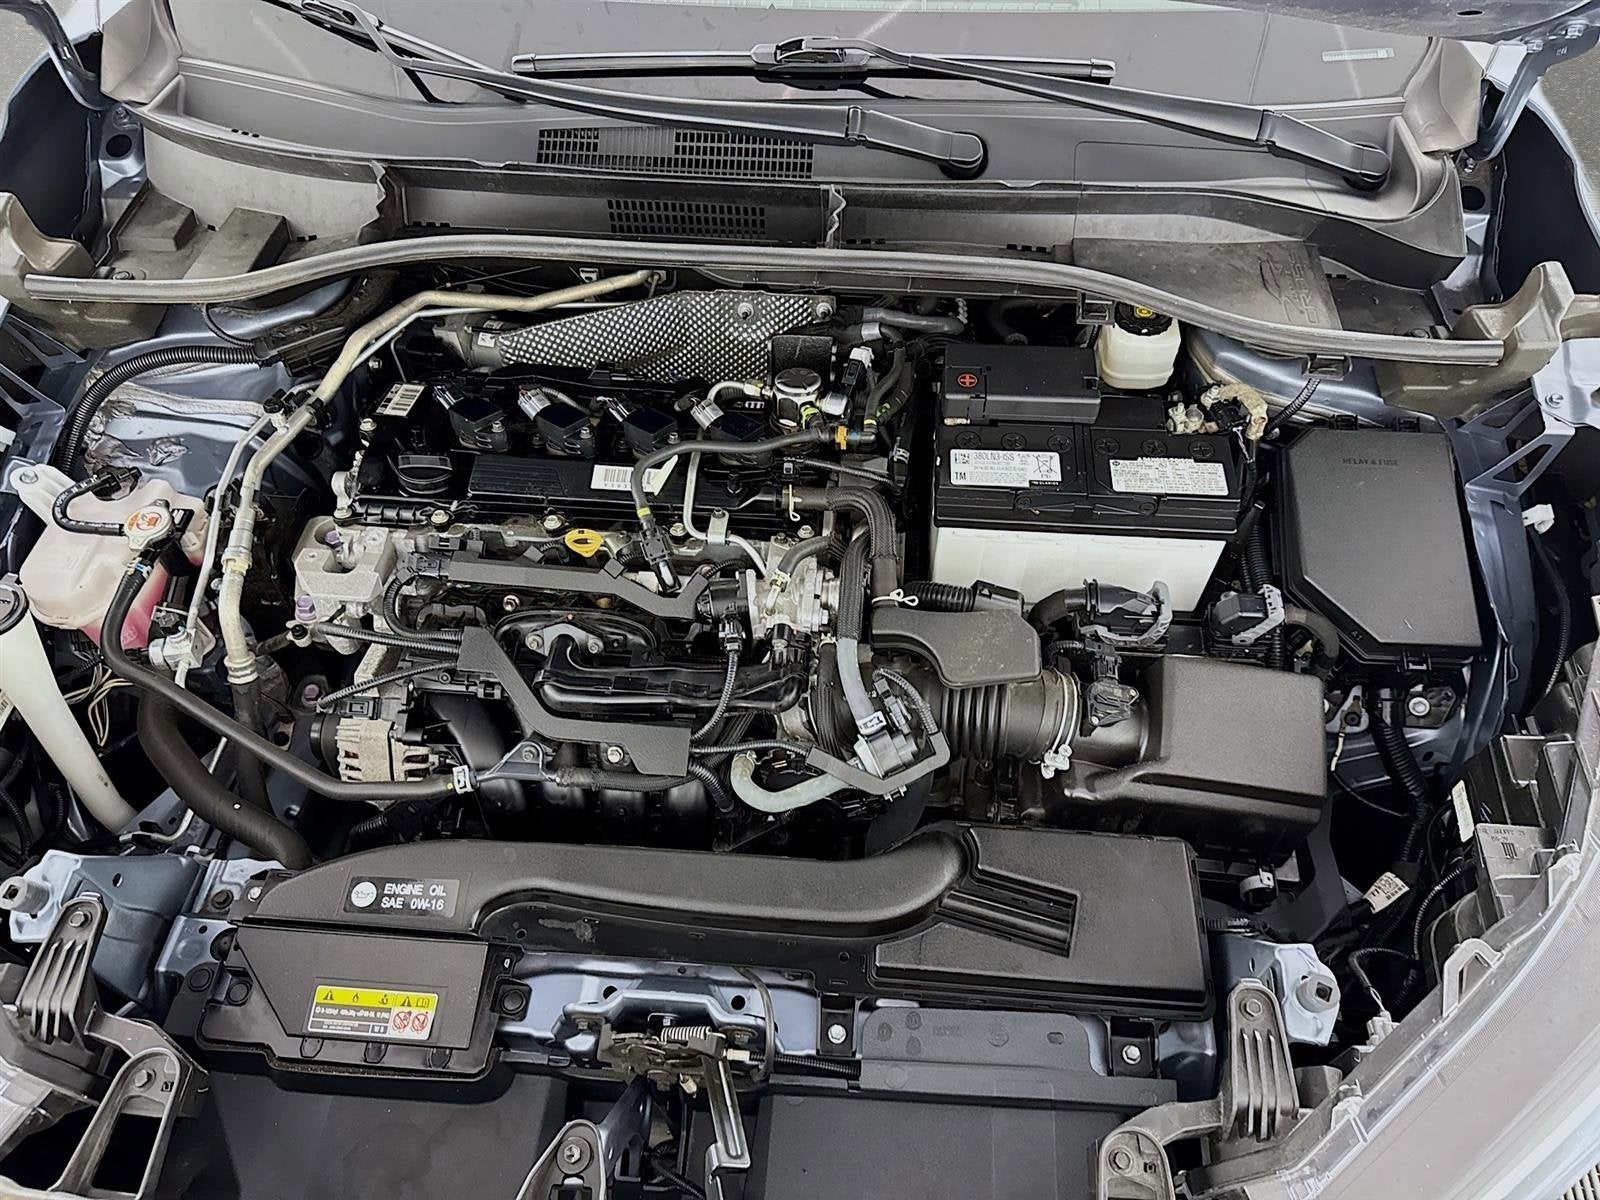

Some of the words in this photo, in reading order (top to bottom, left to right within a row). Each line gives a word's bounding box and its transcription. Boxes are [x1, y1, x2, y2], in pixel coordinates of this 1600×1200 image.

[384, 883, 424, 896] ENGINE
[429, 885, 447, 896] OIL
[381, 897, 405, 908] SAE
[410, 898, 445, 910] 0W-16
